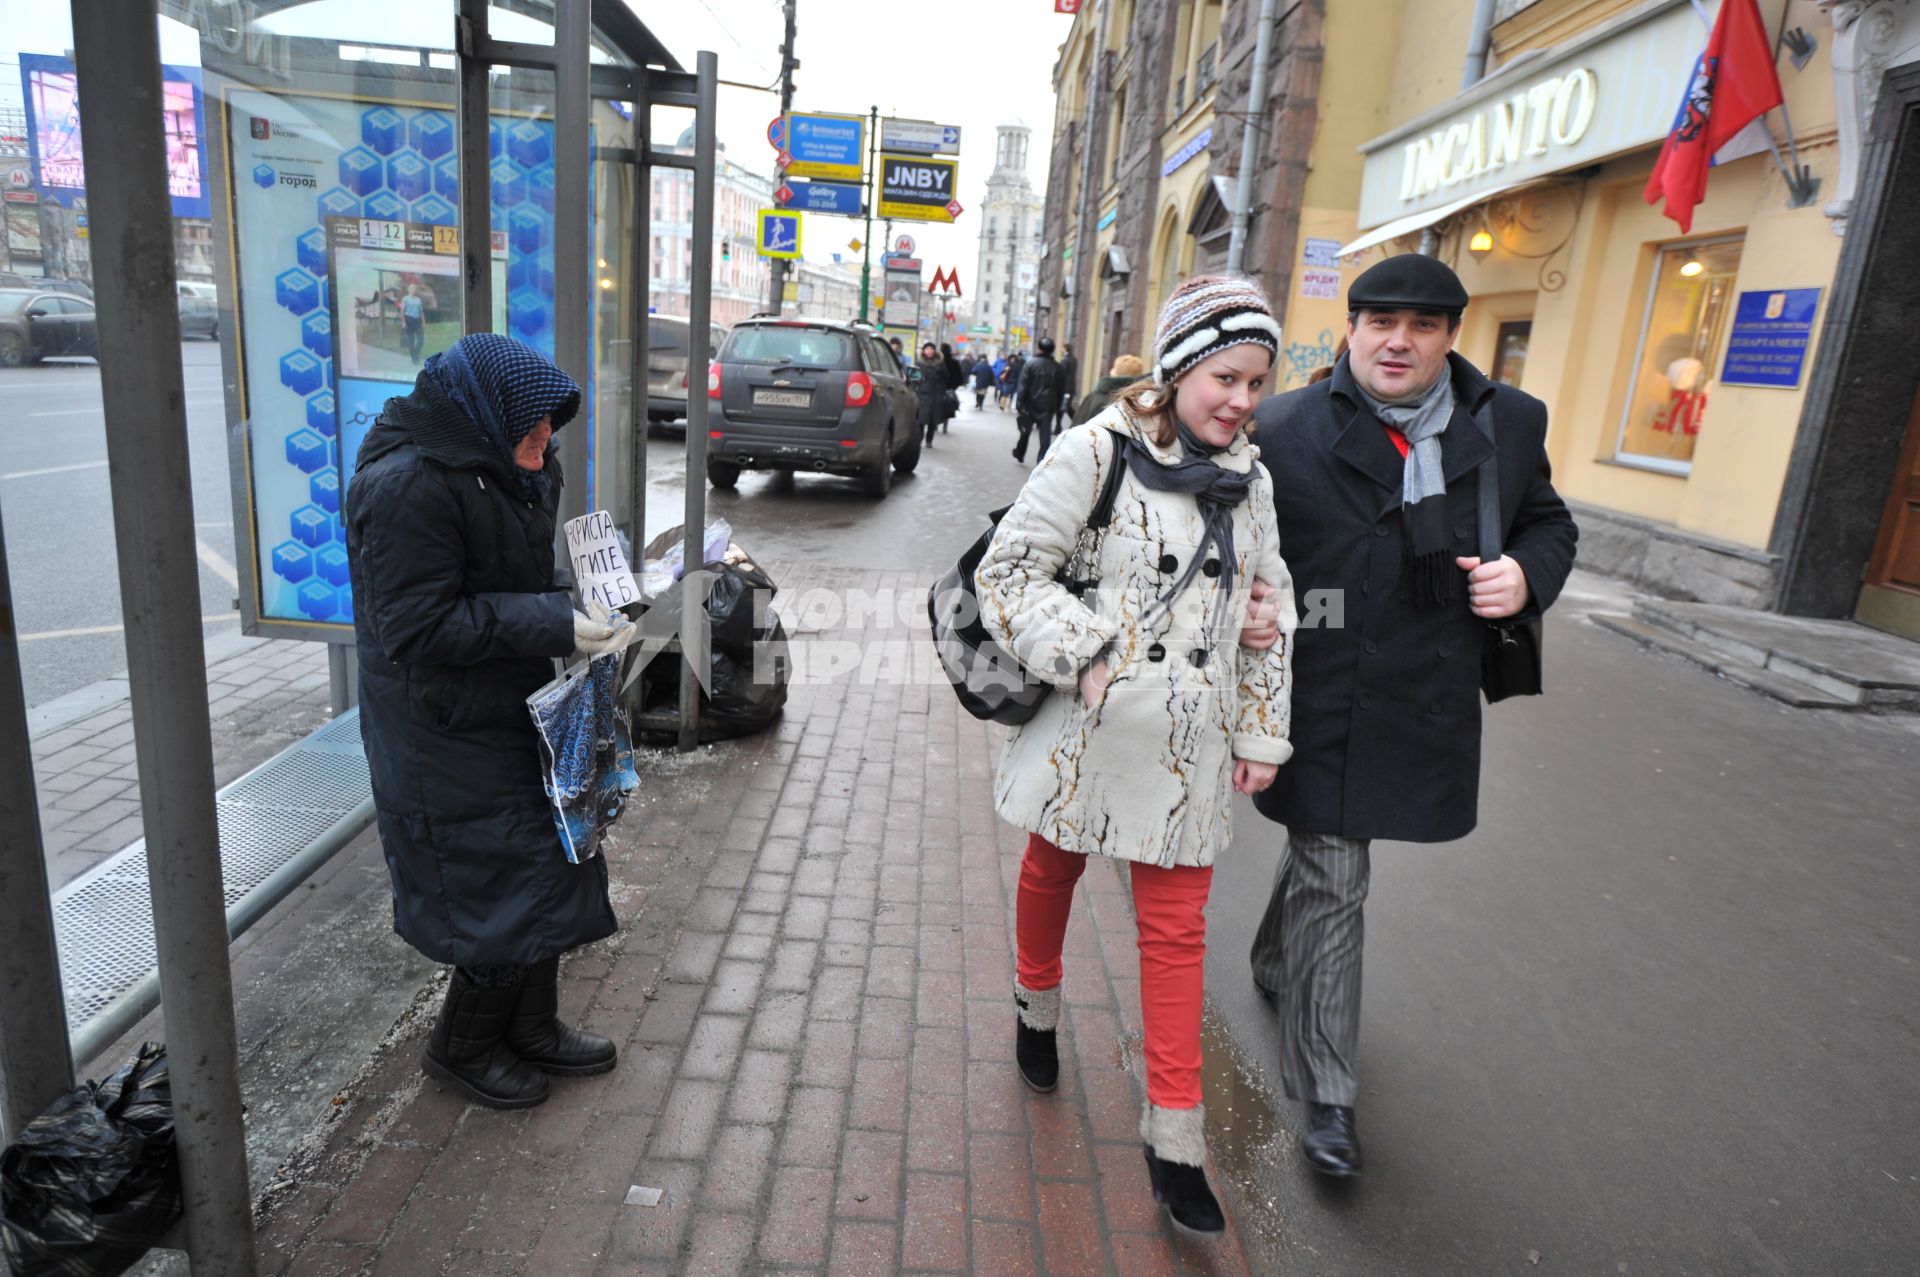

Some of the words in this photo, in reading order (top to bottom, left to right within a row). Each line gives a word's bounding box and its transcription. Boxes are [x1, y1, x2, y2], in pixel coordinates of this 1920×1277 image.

[1399, 66, 1598, 201] INCANTO
[279, 176, 317, 189] город
[887, 166, 949, 189] JNBY
[808, 185, 838, 201] Gallery
[884, 187, 917, 197] МАГАЗИН
[918, 189, 952, 200] ОДЕЖДЫ
[364, 222, 372, 237] 1
[384, 223, 400, 239] 12
[438, 228, 459, 244] 12
[580, 576, 632, 608] ЛЕБ
